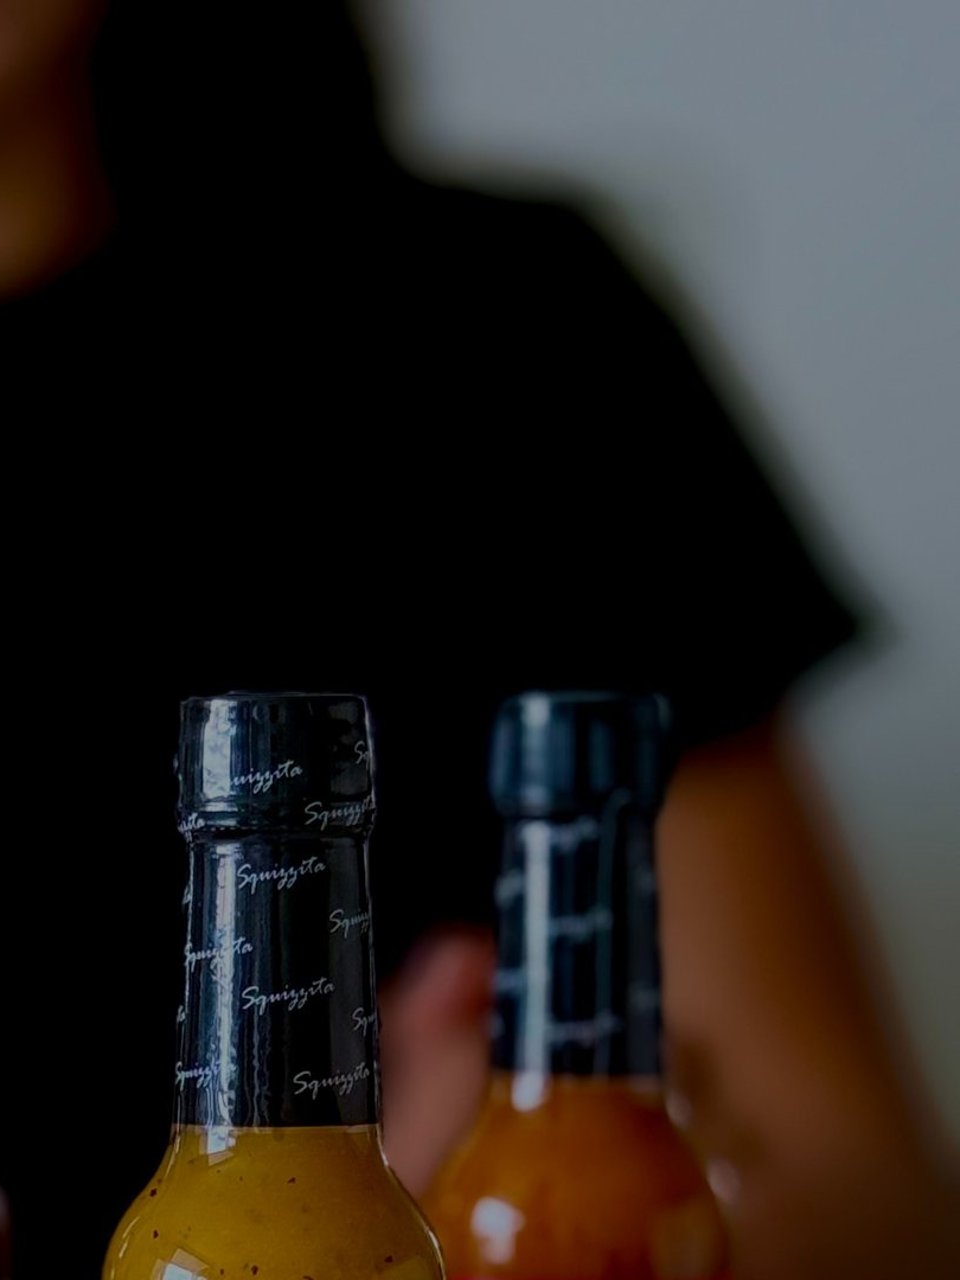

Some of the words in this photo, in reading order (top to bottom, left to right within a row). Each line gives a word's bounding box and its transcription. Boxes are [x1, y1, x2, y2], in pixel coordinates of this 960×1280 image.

[231, 759, 304, 794] uizzita
[237, 856, 327, 895] Squizzita
[241, 976, 336, 1016] Squizzita
[292, 1062, 370, 1100] Squizzita
